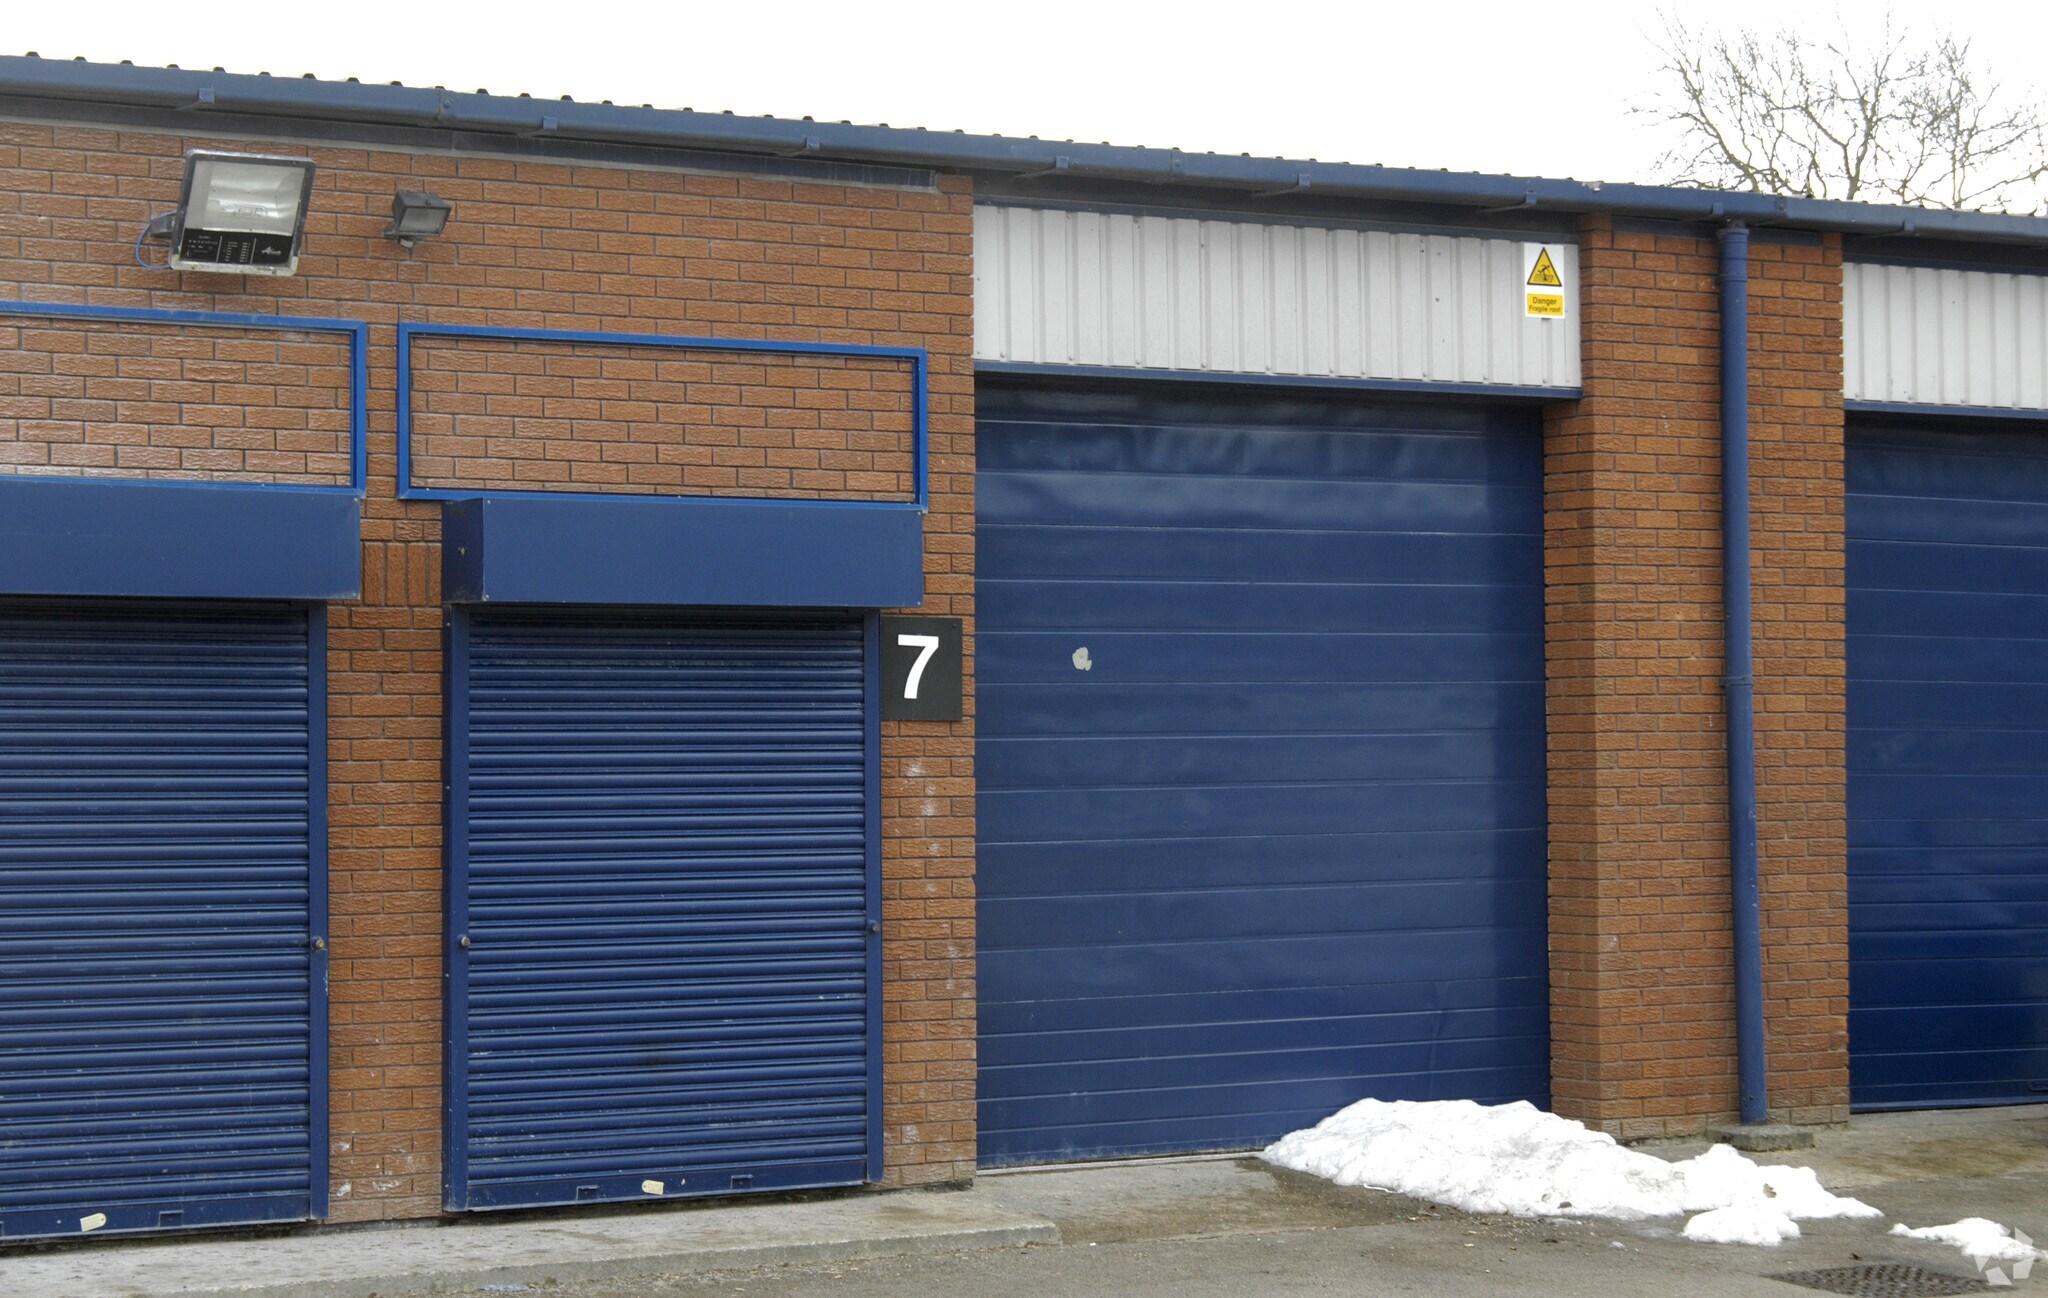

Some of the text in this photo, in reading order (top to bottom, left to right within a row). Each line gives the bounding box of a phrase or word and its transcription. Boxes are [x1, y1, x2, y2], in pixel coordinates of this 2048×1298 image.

[1532, 297, 1557, 306] Danger
[1529, 305, 1548, 313] Fragile
[897, 634, 939, 699] 7
